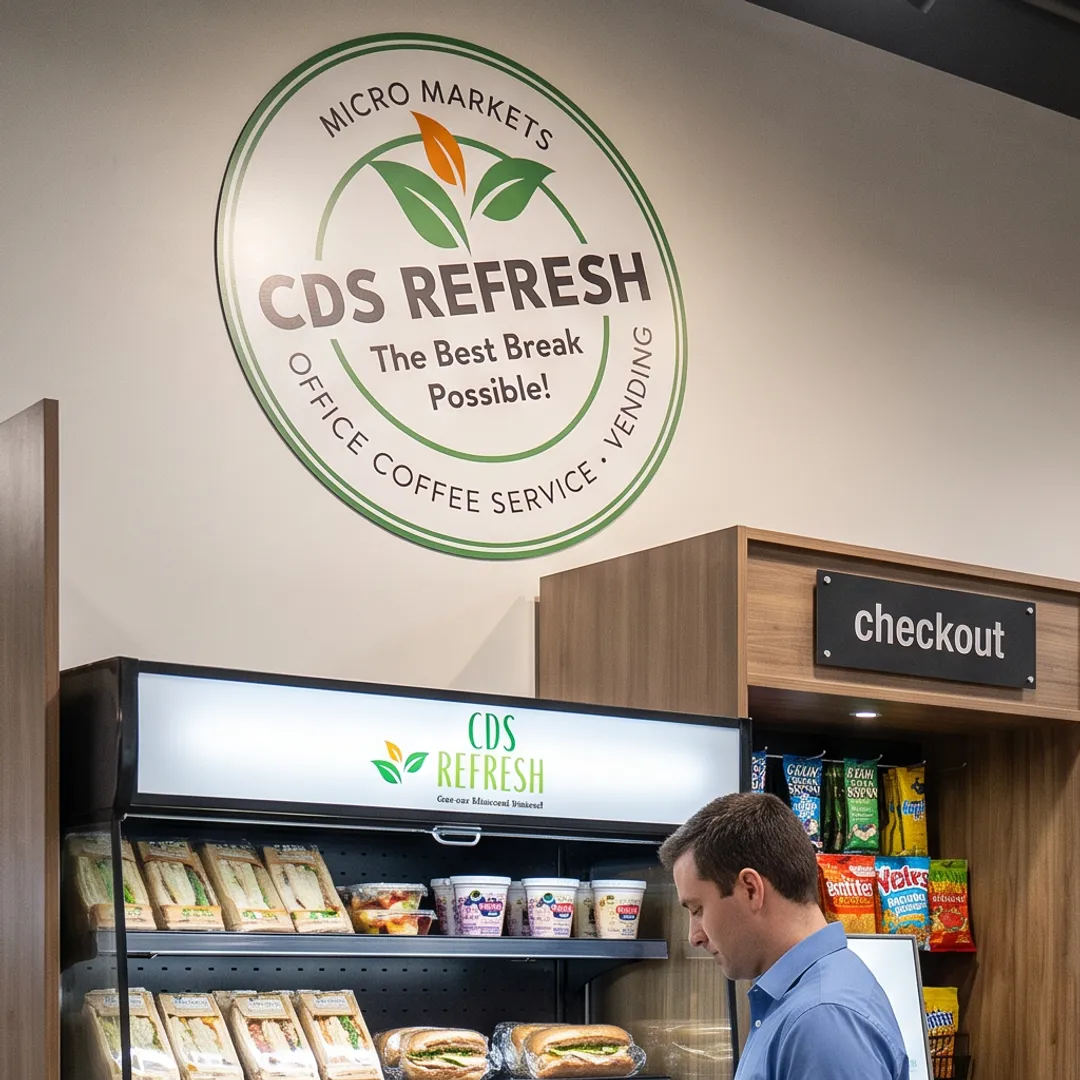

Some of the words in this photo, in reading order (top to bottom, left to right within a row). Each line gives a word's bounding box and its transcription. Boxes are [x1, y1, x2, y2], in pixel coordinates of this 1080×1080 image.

[319, 81, 410, 138] MICRO
[421, 80, 554, 151] MARKETS
[258, 268, 386, 331] CDS
[400, 252, 652, 320] REFRESH
[370, 345, 427, 373] The
[435, 338, 497, 368] Best
[504, 328, 584, 360] Break
[428, 373, 552, 411] Possible!
[288, 352, 369, 455] OFFICE
[372, 451, 481, 513] COFFEE
[491, 462, 598, 515] SERVICE
[604, 326, 653, 451] VENDING
[854, 602, 1006, 660] checkout
[468, 712, 516, 752] CDS
[437, 751, 544, 794] REFRESH
